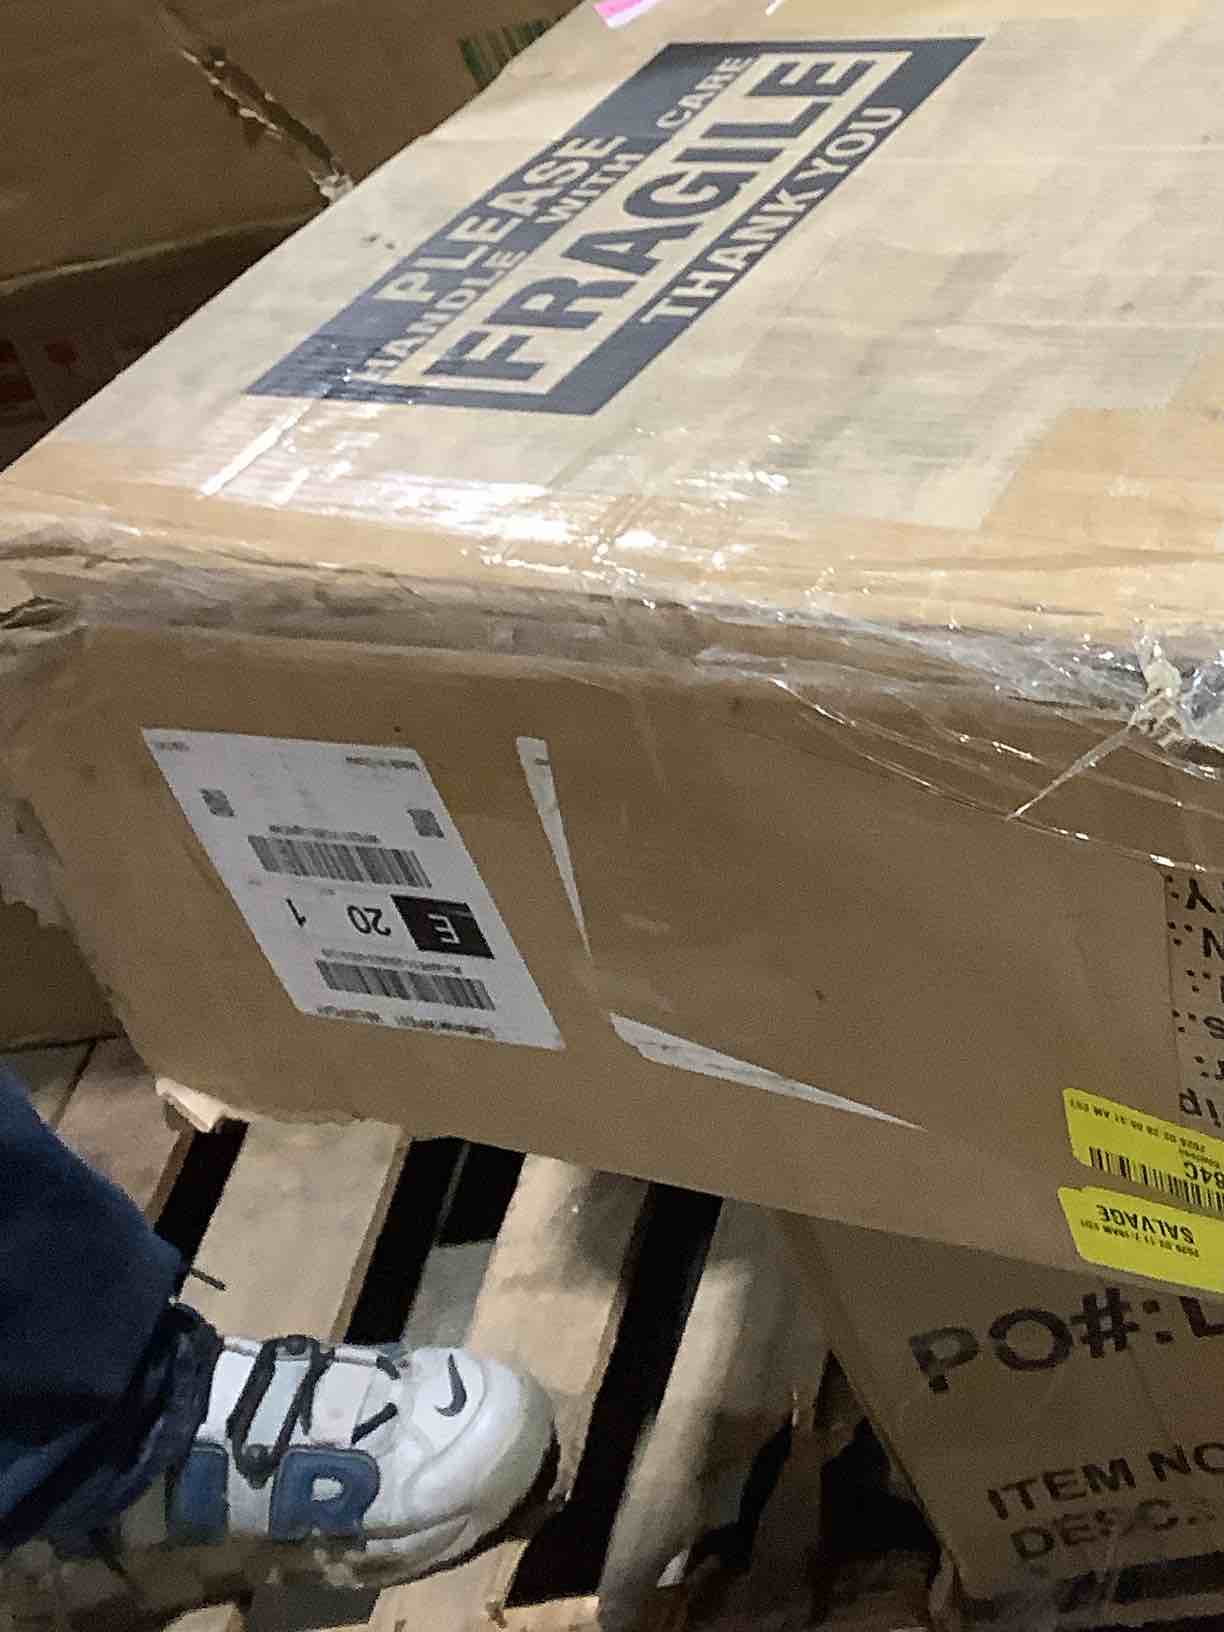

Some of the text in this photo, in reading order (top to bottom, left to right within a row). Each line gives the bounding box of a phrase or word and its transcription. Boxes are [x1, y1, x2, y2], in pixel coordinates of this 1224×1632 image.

[349, 56, 755, 382] HANDLE WITH CARE
[372, 134, 628, 304] PLEASE
[420, 58, 880, 382] FRAGILE
[640, 106, 904, 324] THANK YOU
[346, 905, 392, 937] 20
[430, 913, 461, 945] E
[1095, 1202, 1196, 1246] SALVAGE
[987, 1457, 1136, 1521] ITEM
